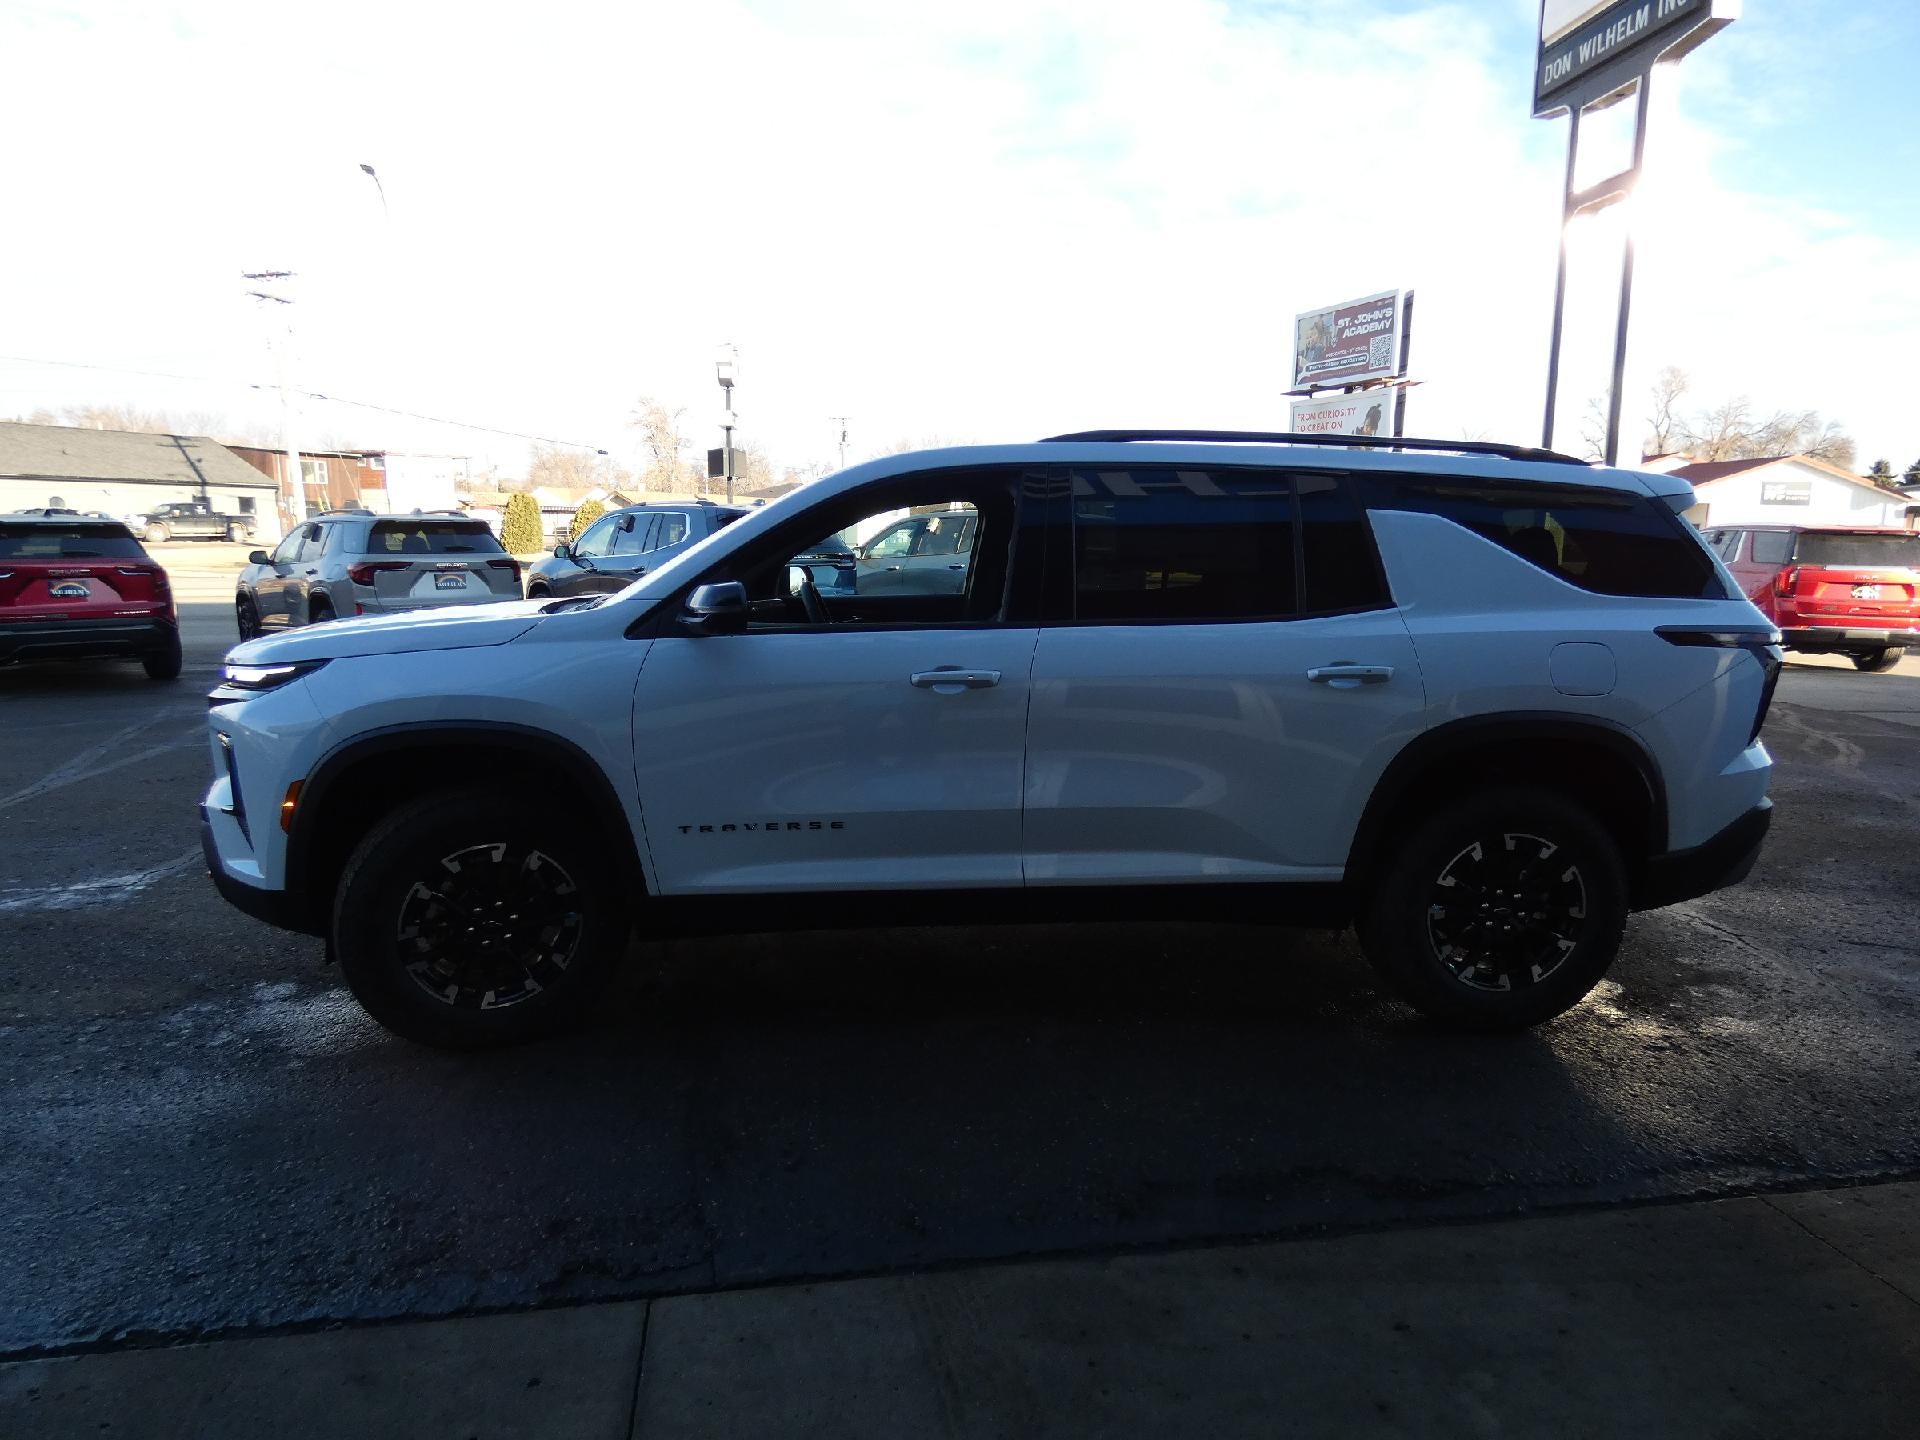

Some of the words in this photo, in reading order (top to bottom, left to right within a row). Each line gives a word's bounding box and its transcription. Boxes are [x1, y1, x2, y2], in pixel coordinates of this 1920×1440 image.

[1544, 51, 1572, 86] DON
[1579, 4, 1649, 65] WILHELM
[1337, 317, 1352, 328] ST.
[1354, 307, 1393, 324] JOHN'S
[1342, 318, 1392, 338] ACADEMY
[1317, 407, 1356, 420] CURIOSITY
[1307, 420, 1343, 432] CREATION
[678, 821, 844, 834] TRAVERSE
